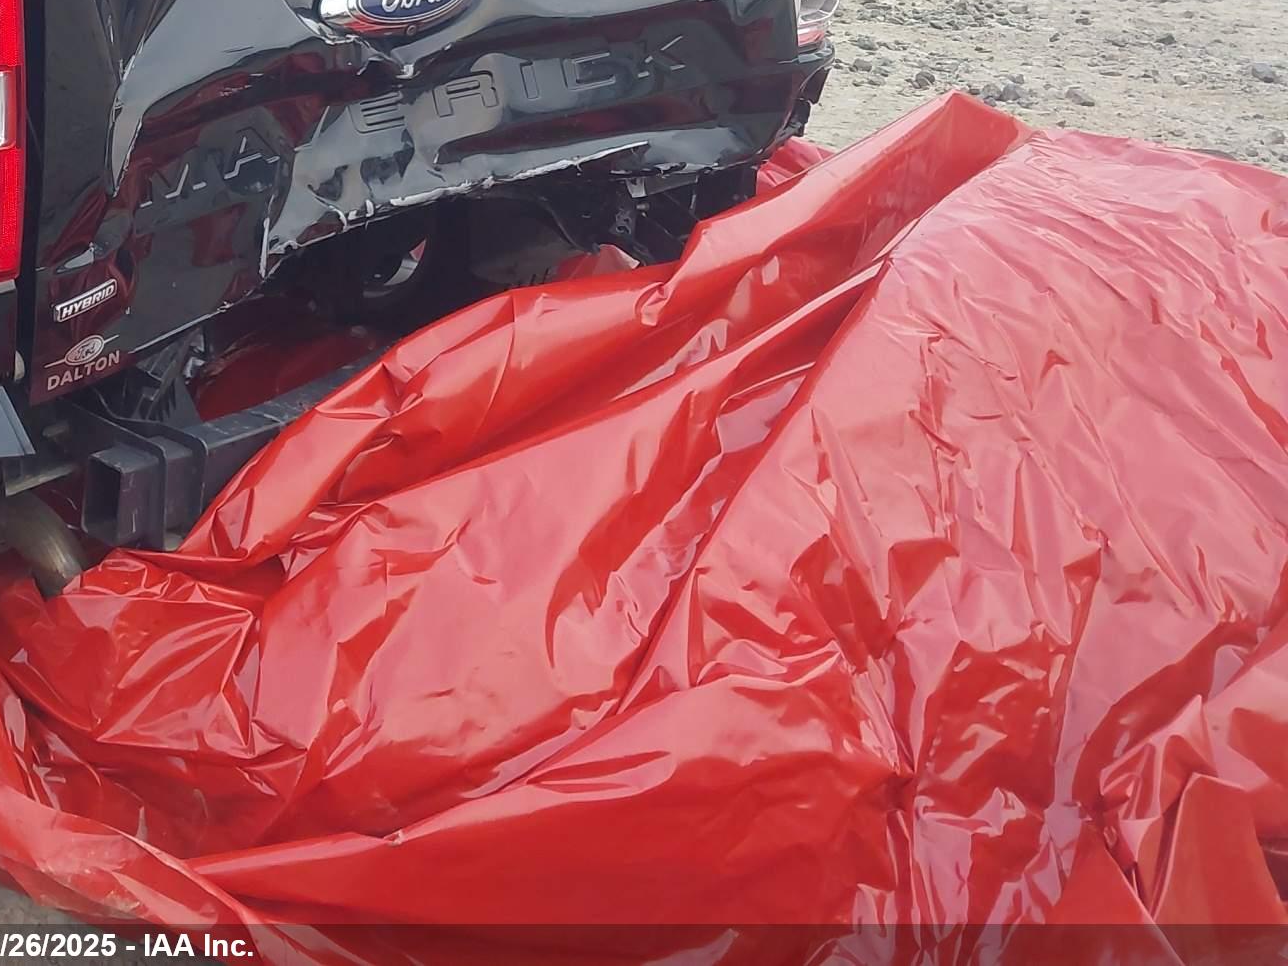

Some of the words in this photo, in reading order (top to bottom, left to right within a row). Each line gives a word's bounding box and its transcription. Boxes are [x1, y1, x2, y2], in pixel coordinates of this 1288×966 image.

[139, 34, 688, 209] MAERICK
[61, 284, 115, 319] HYBRID
[47, 350, 120, 391] DALTON
